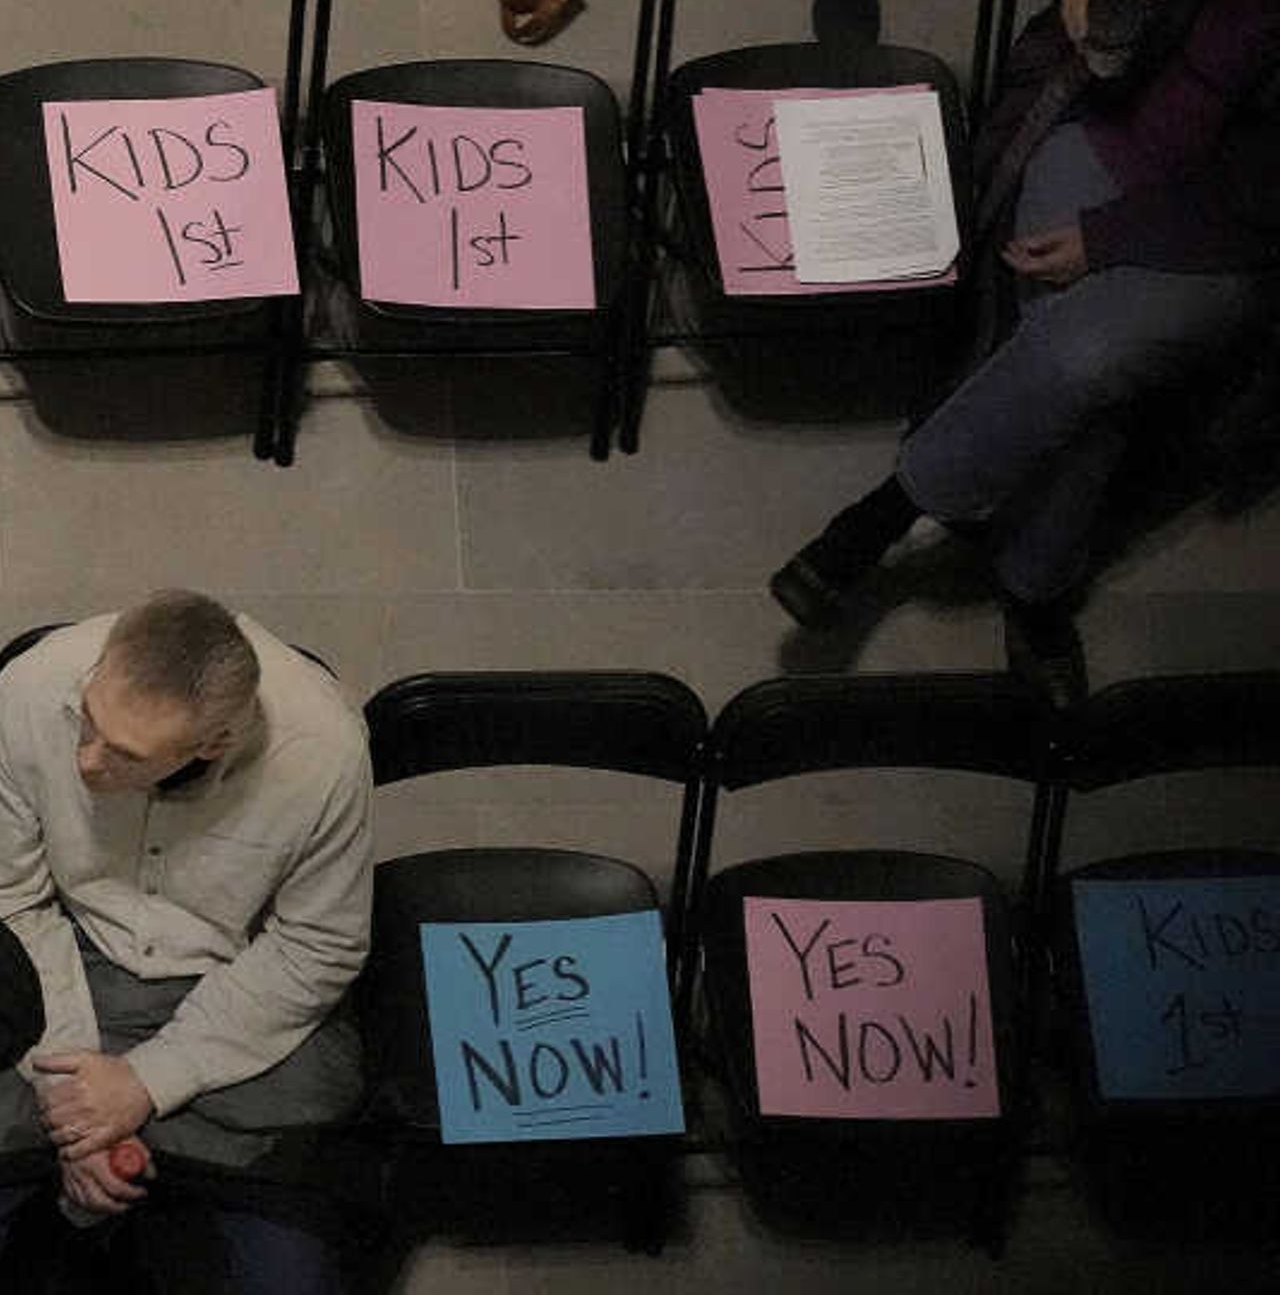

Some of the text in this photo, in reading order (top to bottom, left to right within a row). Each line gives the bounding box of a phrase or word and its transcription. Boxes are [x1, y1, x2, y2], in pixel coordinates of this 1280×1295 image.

[60, 111, 250, 202] KIDS
[376, 115, 533, 204] KIDS
[157, 207, 244, 287] 1st
[451, 207, 523, 291] 1st
[458, 931, 591, 1028] YES
[771, 911, 905, 1001] YES
[460, 1009, 652, 1113] NOW!
[794, 992, 977, 1091] NOW!
